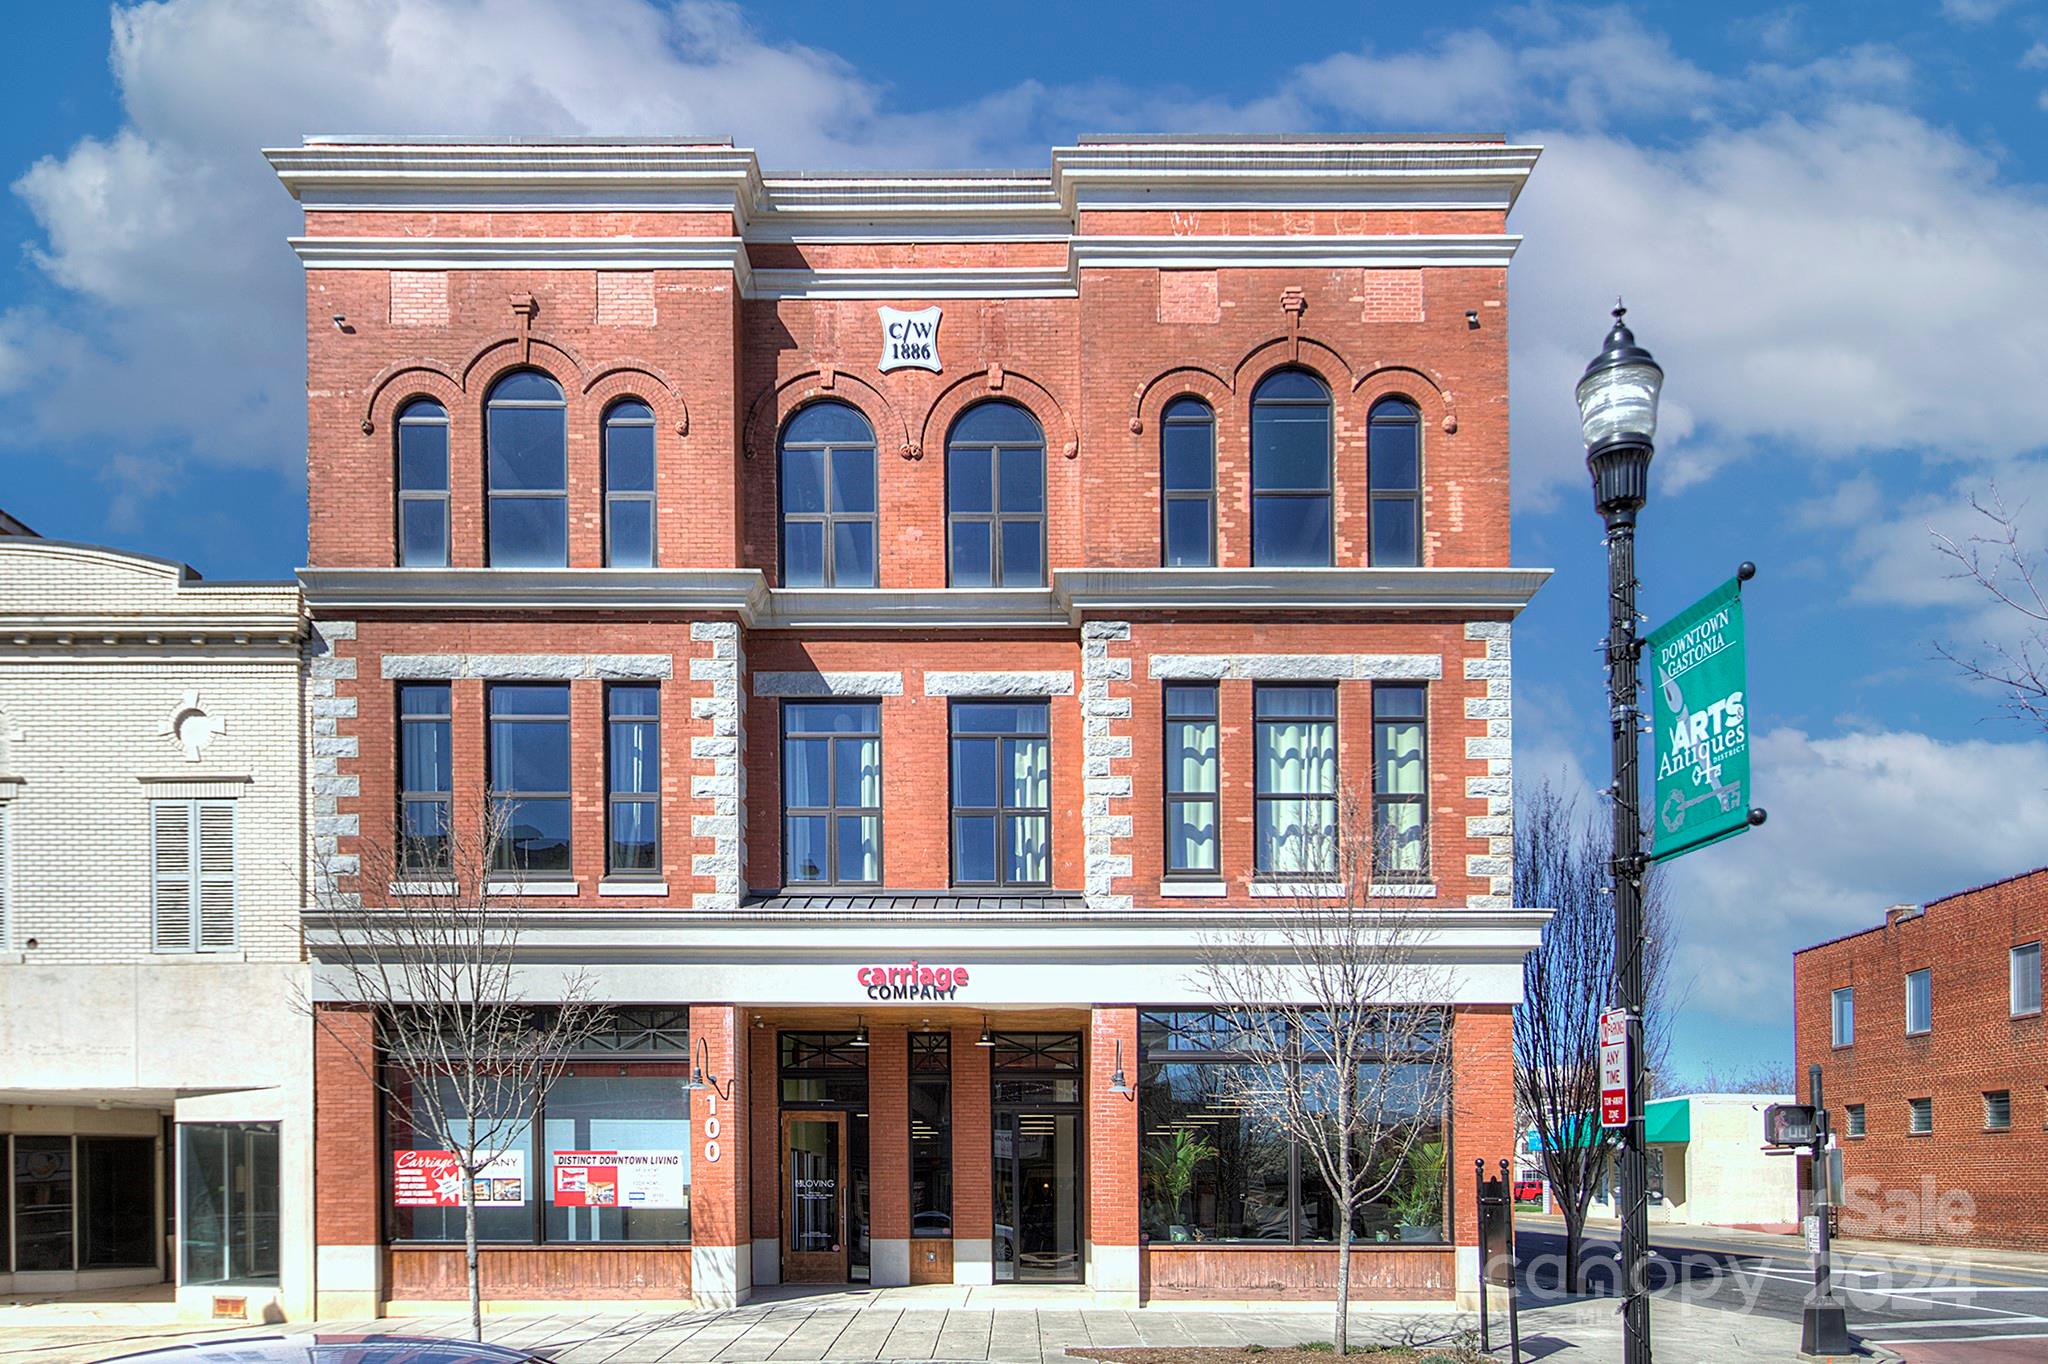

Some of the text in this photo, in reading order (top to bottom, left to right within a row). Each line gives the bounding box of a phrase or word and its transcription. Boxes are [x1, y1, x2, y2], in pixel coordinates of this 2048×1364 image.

[889, 320, 932, 343] C/W
[893, 343, 931, 360] 1886
[1661, 609, 1729, 665] DOWNTOWN
[1668, 632, 1725, 677] GASTONIA
[1669, 691, 1744, 757] ARTS
[1657, 724, 1745, 784] Antiques
[1712, 744, 1745, 764] DISTRICT
[857, 960, 969, 993] carriage
[867, 985, 958, 1000] COMPANY
[1605, 1050, 1620, 1066] ANY
[1606, 1069, 1620, 1084] TIME
[704, 1094, 721, 1163] 100
[396, 1151, 454, 1178] Carriage
[558, 1156, 679, 1165] DISTINCT DOWNTOWN LIVING
